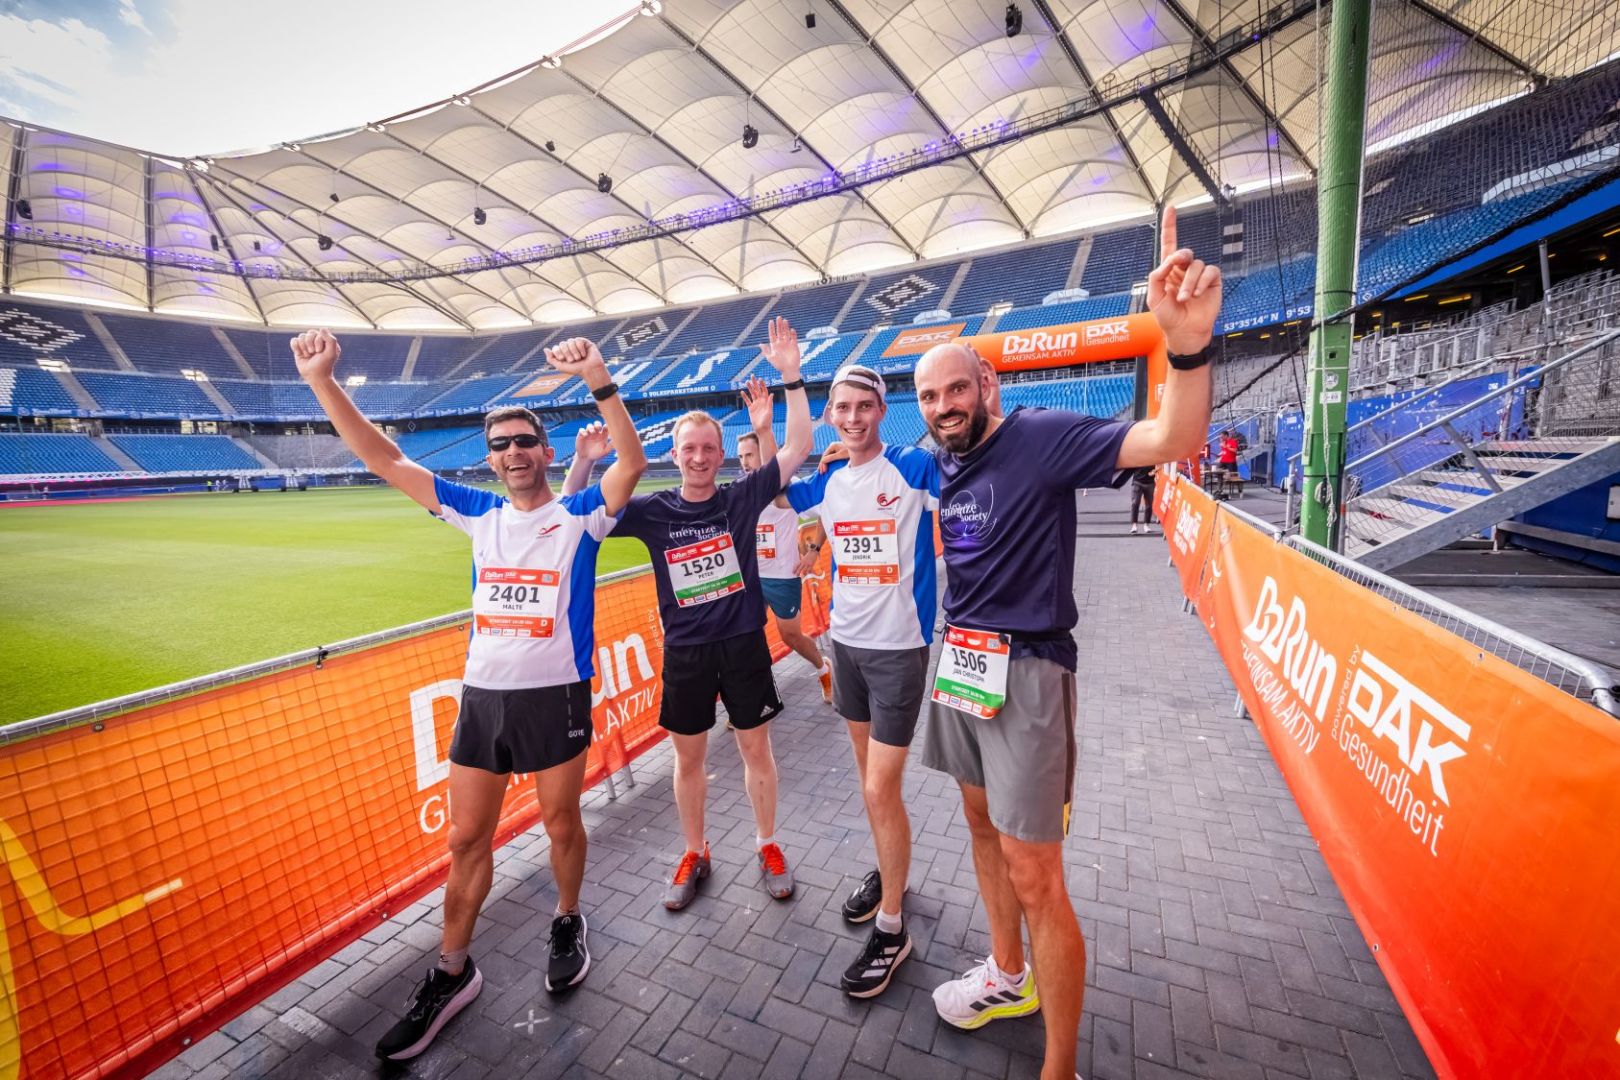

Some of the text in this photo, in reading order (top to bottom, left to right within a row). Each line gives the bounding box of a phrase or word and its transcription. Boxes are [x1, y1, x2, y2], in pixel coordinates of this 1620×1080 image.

[1270, 312, 1279, 321] N
[1086, 320, 1129, 338] DAK
[1086, 333, 1130, 346] Gesundheit
[1002, 331, 1078, 355] B2Run
[1051, 348, 1076, 358] AKTIV
[648, 386, 709, 397] VOLKSPARKSTADION
[843, 537, 883, 553] 2391
[681, 553, 725, 577] 1520
[698, 571, 714, 579] PETER
[489, 585, 540, 603] 2401
[1242, 575, 1338, 722] B2Run
[951, 647, 987, 675] 1506
[1331, 643, 1361, 740] powered by
[606, 683, 658, 735] AKTIV
[1277, 700, 1320, 754] AKTIV
[1346, 649, 1472, 808] DAK
[1339, 715, 1444, 857] Gesundheit
